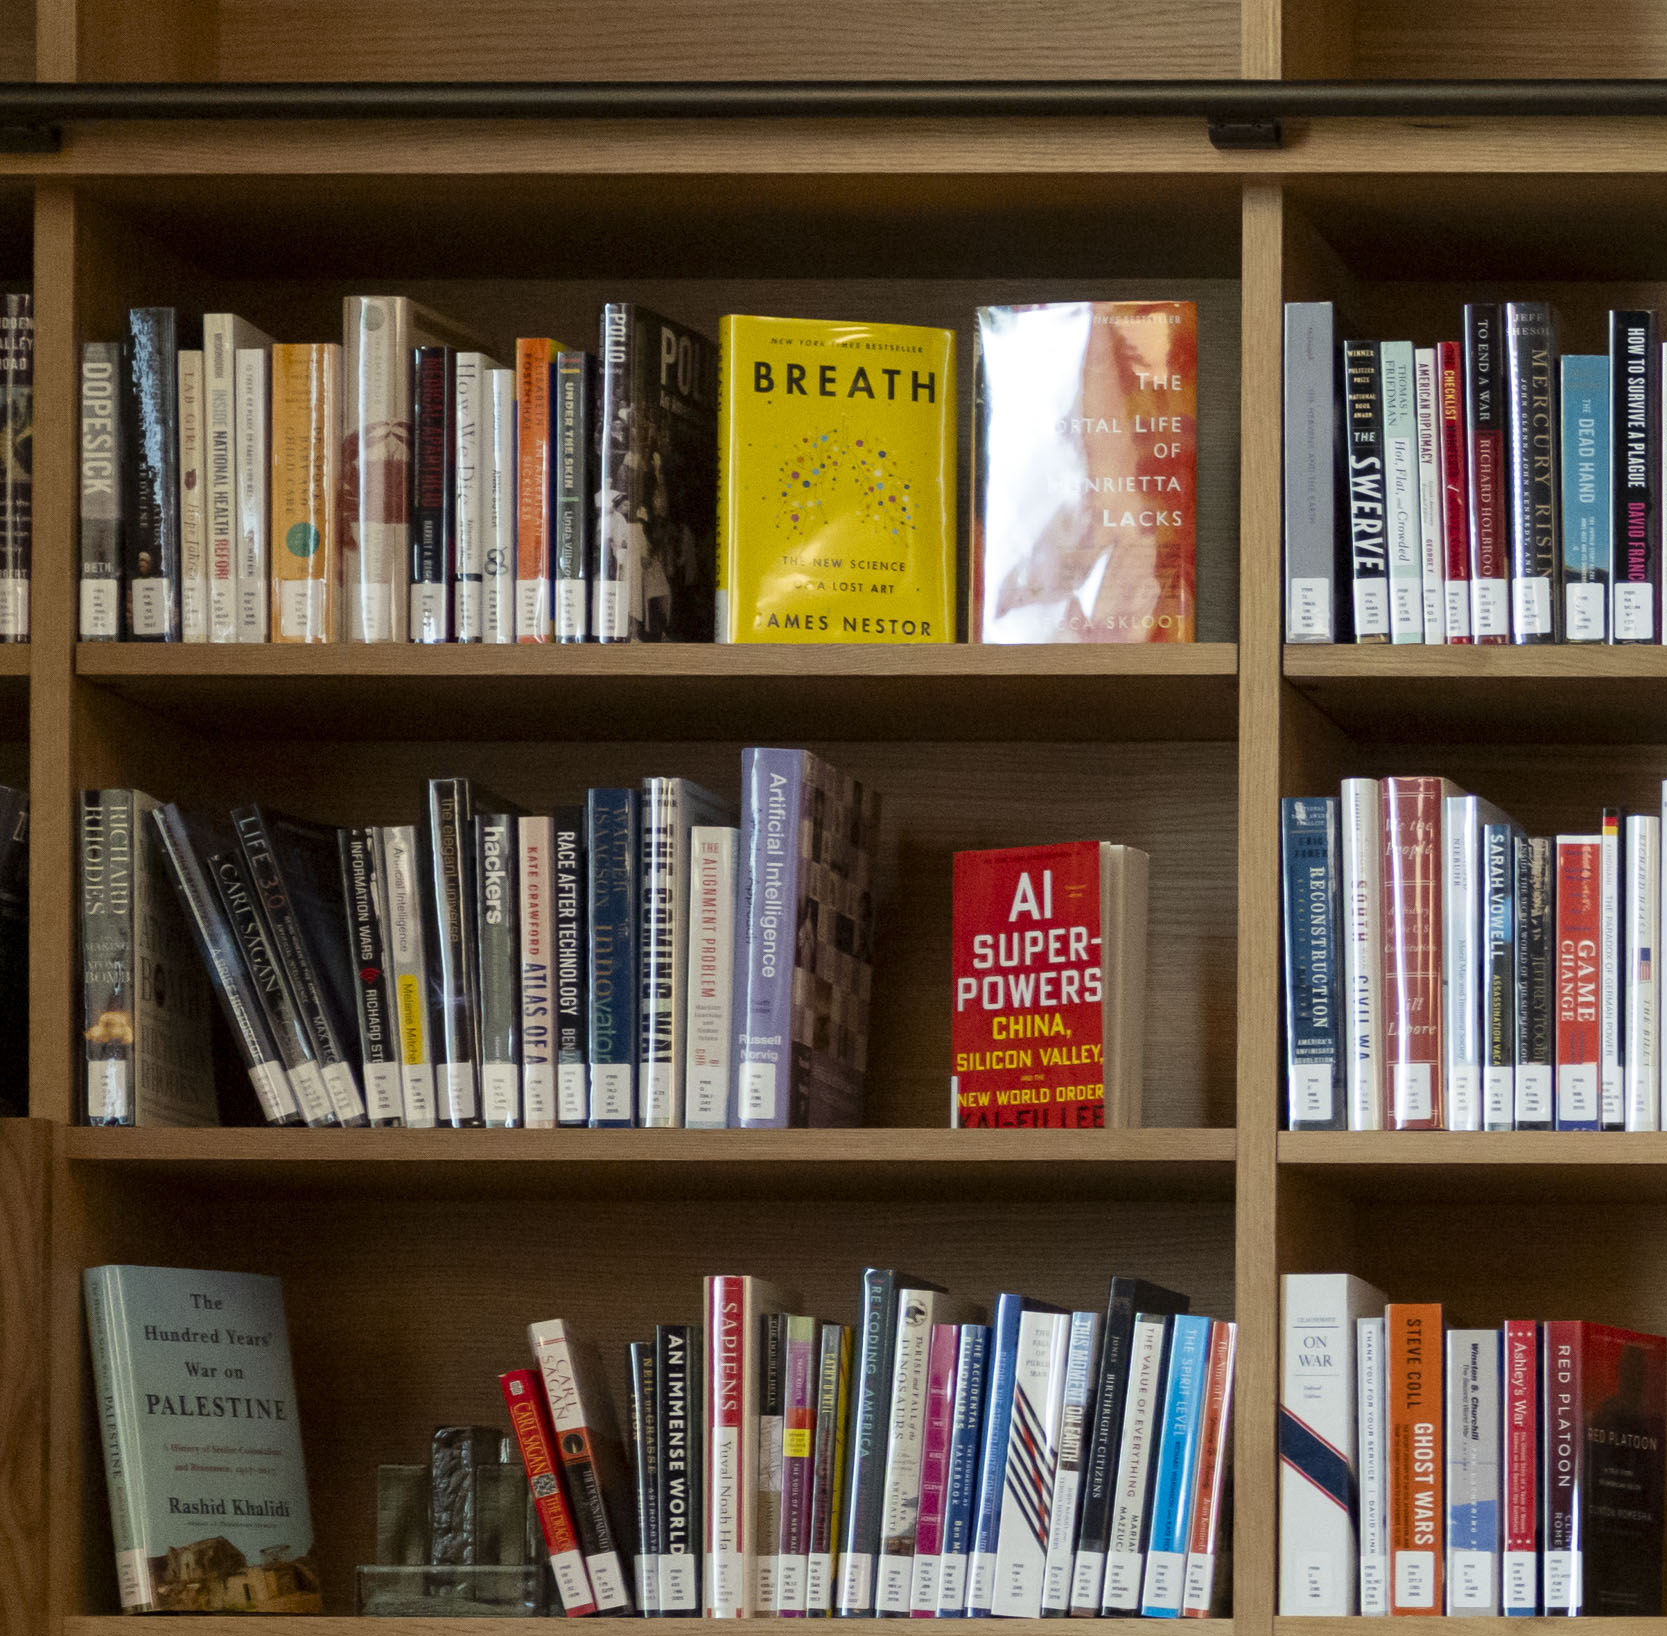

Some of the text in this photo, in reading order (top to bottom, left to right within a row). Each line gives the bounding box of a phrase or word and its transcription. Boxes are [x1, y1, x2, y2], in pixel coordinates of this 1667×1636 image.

[754, 361, 936, 403] BREATH
[1627, 328, 1644, 488] HOW TO SURVIVE A PLAGUE
[82, 362, 113, 495] DOPESICK
[1353, 432, 1376, 442] THE
[213, 430, 229, 536] NATIONAL HEALTH
[1103, 510, 1182, 527] LACKS
[1350, 455, 1384, 572] SWERVE
[484, 826, 506, 925] hackers
[760, 773, 787, 978] Artificial Intelligence
[1009, 870, 1051, 922] AI
[1490, 835, 1504, 959] SARAH VOWELL
[558, 831, 577, 1016] RACE AFTER TECHNOLOGY
[973, 926, 1103, 969] SUPER-
[958, 968, 1102, 1011] POWERS
[1561, 941, 1574, 1022] CHANGE
[1577, 941, 1595, 1022] GAME
[957, 1050, 1031, 1071] SILICON
[992, 1016, 1072, 1040] CHINA,
[958, 1083, 1104, 1107] NEW WORLD ORDER
[721, 1301, 737, 1411] SAPIENS
[147, 1394, 286, 1421] PALESTINE
[1558, 1345, 1571, 1487] RED PLATOON
[668, 1335, 684, 1555] AN IMMENSE WORLD
[1414, 1423, 1433, 1485] GHOST
[169, 1497, 290, 1518] Rashid Khalidi
[1415, 1491, 1433, 1546] WARS
